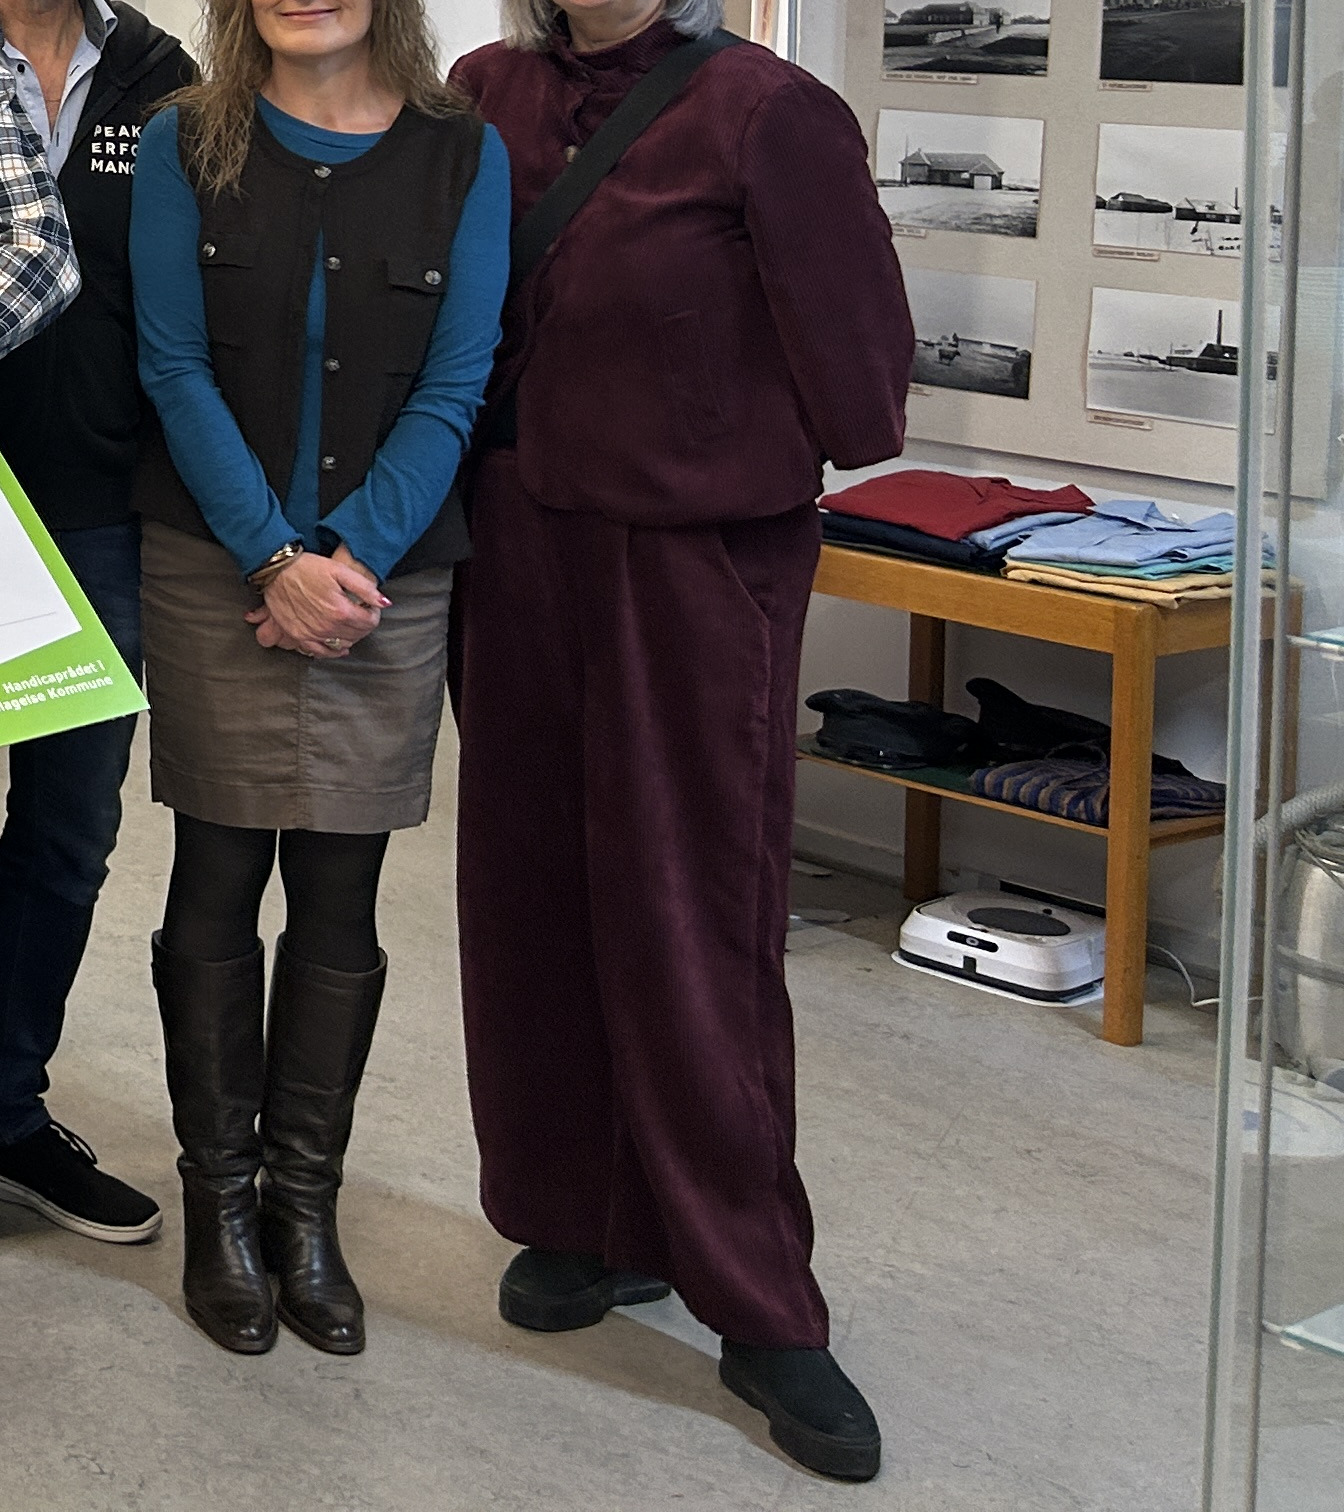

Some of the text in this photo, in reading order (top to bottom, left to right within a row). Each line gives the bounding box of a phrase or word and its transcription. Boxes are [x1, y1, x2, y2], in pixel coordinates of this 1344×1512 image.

[93, 124, 142, 139] PEAK
[2, 662, 98, 694] Handicaprådet
[47, 676, 114, 700] Kommune
